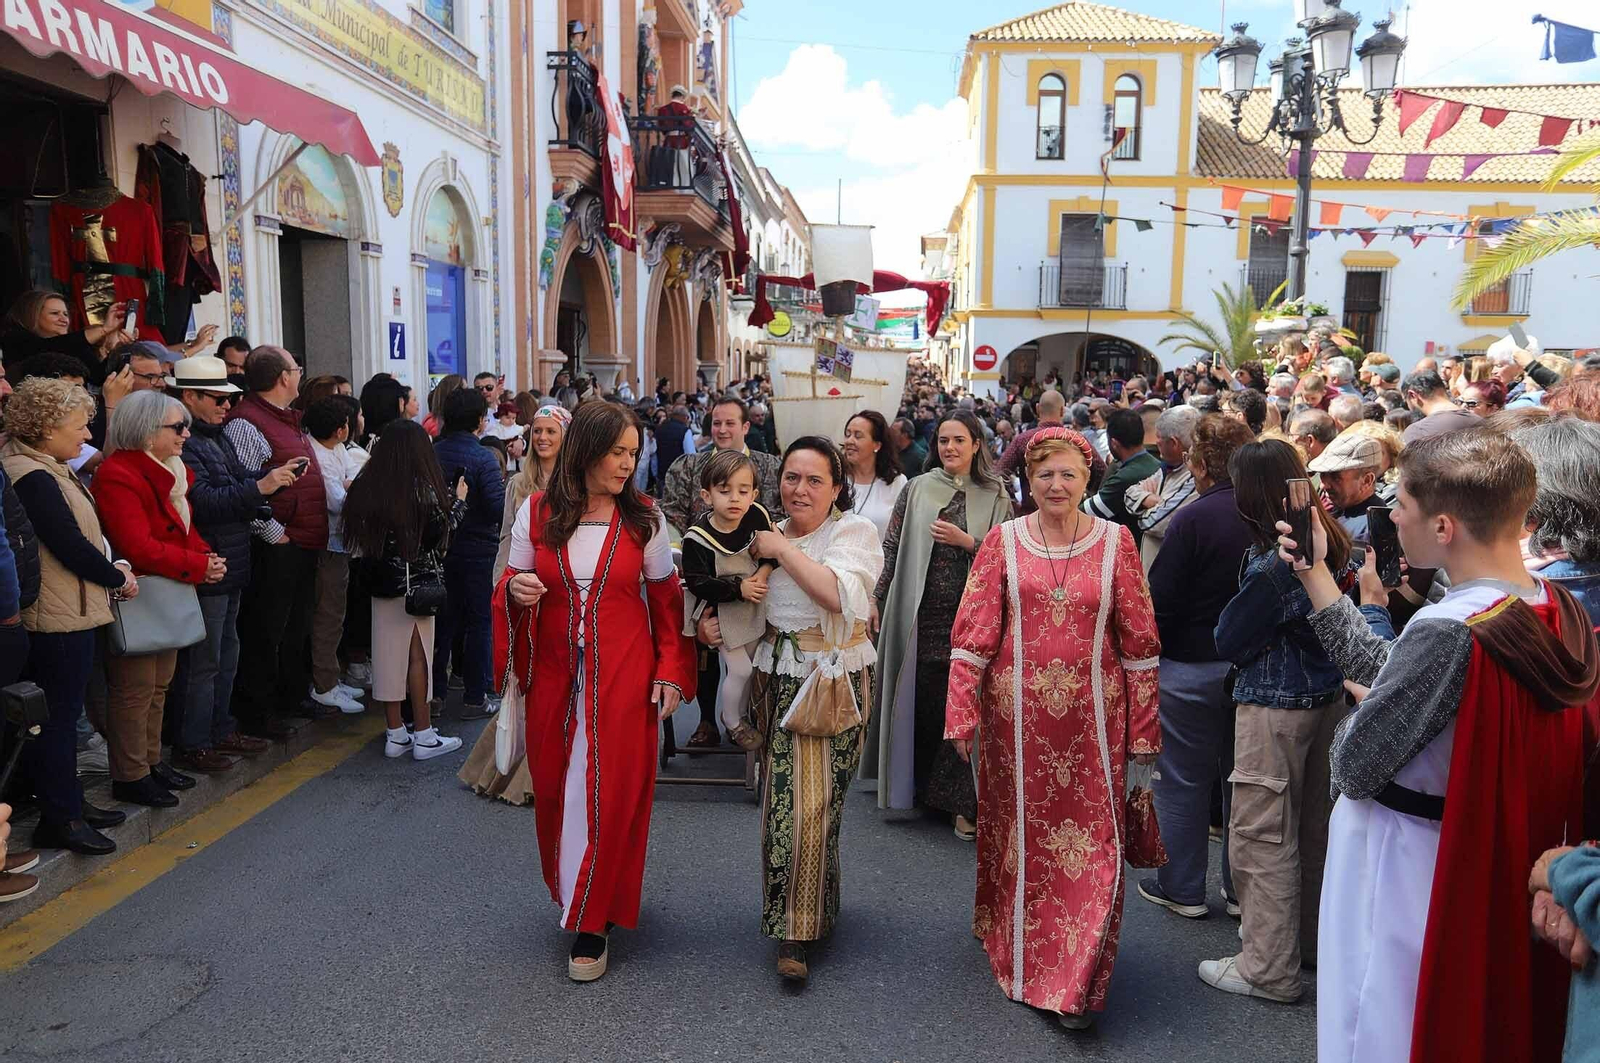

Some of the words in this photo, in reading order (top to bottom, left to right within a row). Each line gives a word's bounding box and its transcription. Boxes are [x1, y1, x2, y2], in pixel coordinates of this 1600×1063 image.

[3, 0, 230, 105] ARMARIO
[320, 0, 393, 59] Municipal
[397, 45, 409, 71] de
